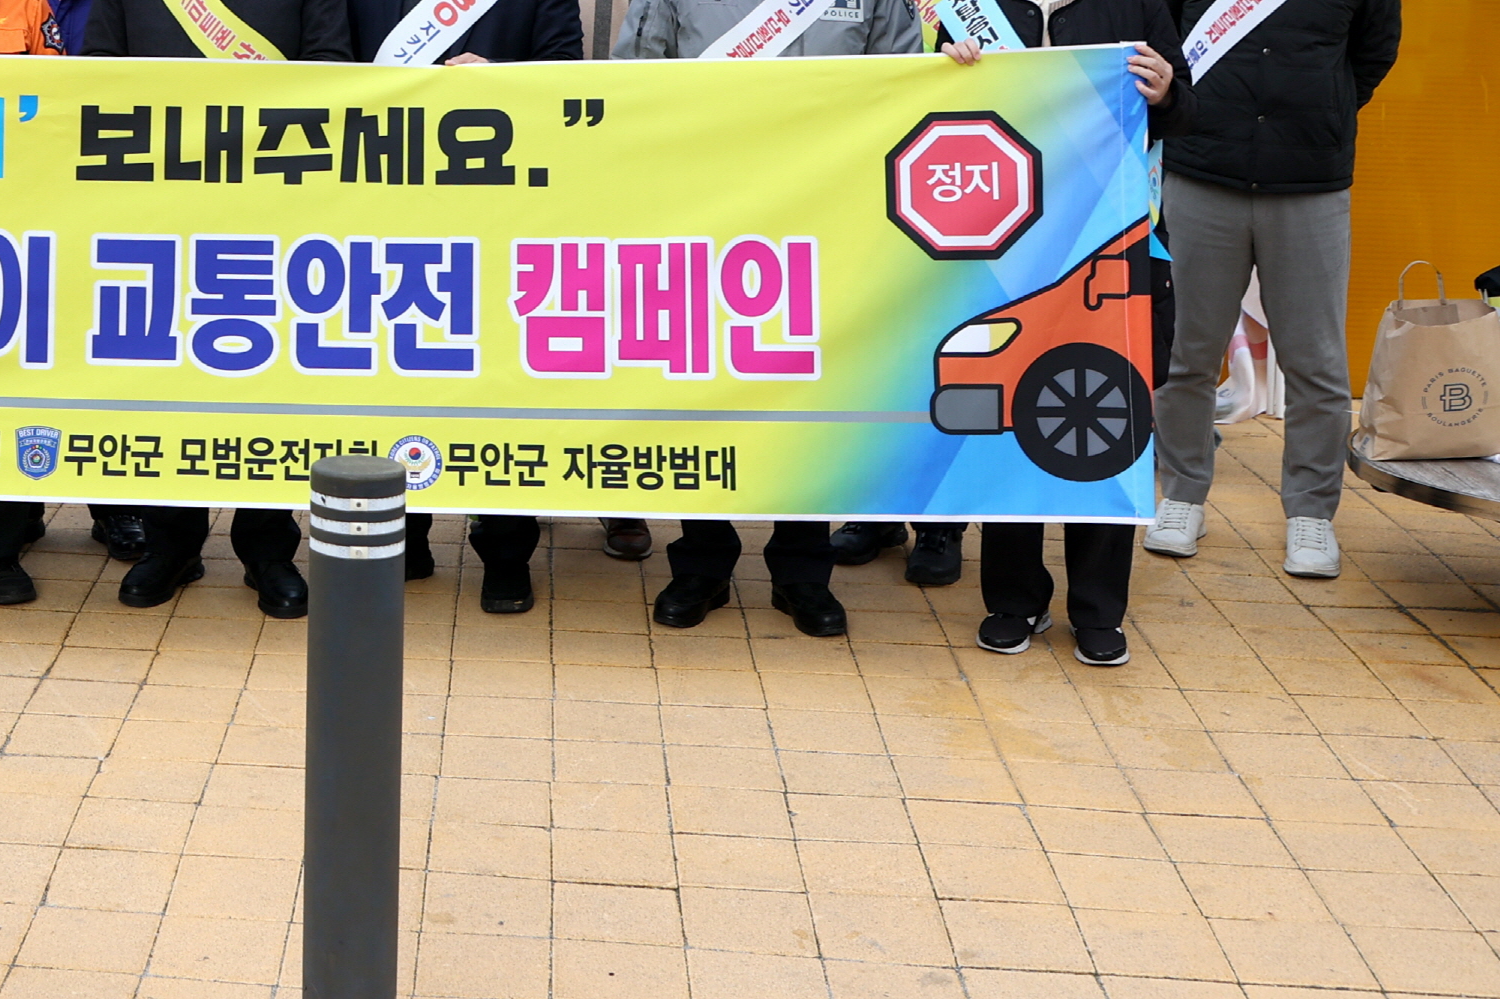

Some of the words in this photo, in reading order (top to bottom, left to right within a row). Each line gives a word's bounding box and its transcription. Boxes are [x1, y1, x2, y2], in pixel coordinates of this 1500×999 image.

[824, 10, 859, 18] POLICE
[925, 162, 1000, 202] 정지
[91, 237, 476, 373] 교통안전
[514, 240, 816, 375] 캠페인
[1423, 371, 1444, 393] PARIS
[1448, 367, 1488, 387] BAGUETTE
[19, 429, 34, 438] BEST
[36, 429, 58, 439] DRIVER
[1426, 408, 1484, 427] BOULANGERIE
[63, 434, 164, 478] 무안군
[445, 442, 547, 487] 무안군
[562, 443, 738, 491] 자율방범대
